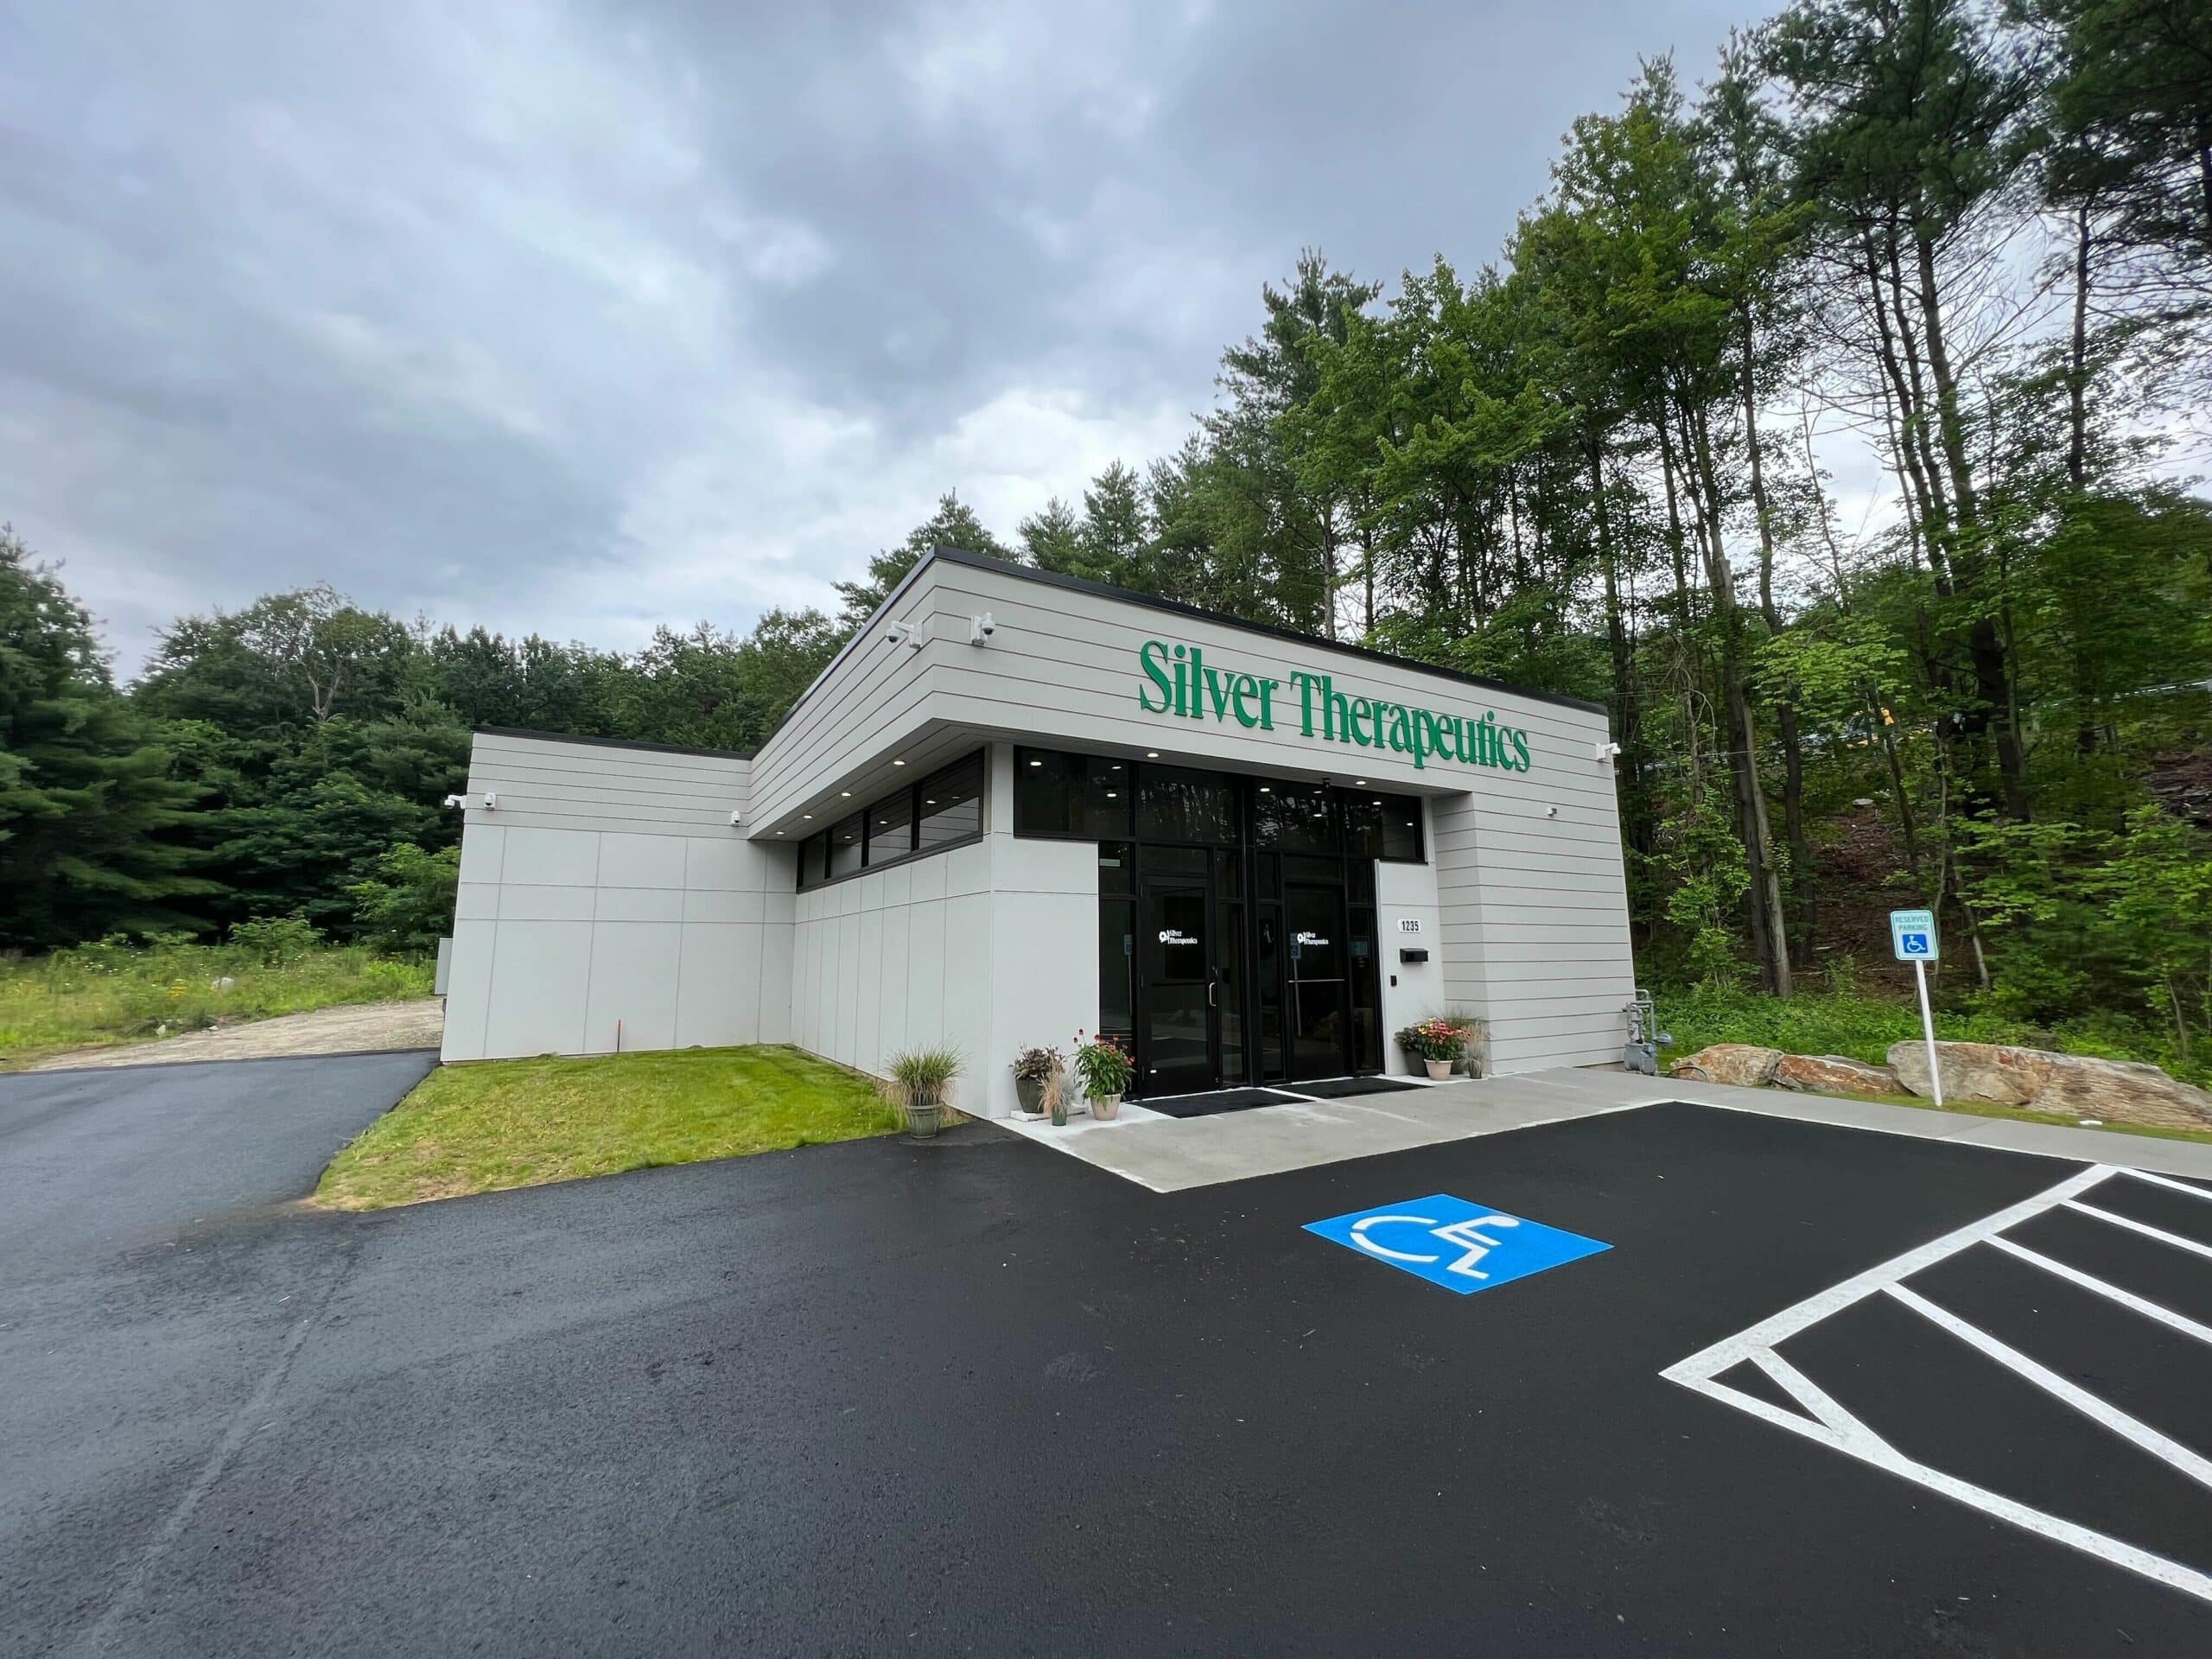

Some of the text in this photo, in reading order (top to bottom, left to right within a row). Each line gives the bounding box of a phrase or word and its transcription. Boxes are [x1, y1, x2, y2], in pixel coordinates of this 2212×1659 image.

[1139, 640, 1531, 772] Silver Therapeutics
[1402, 920, 1419, 931] 1235
